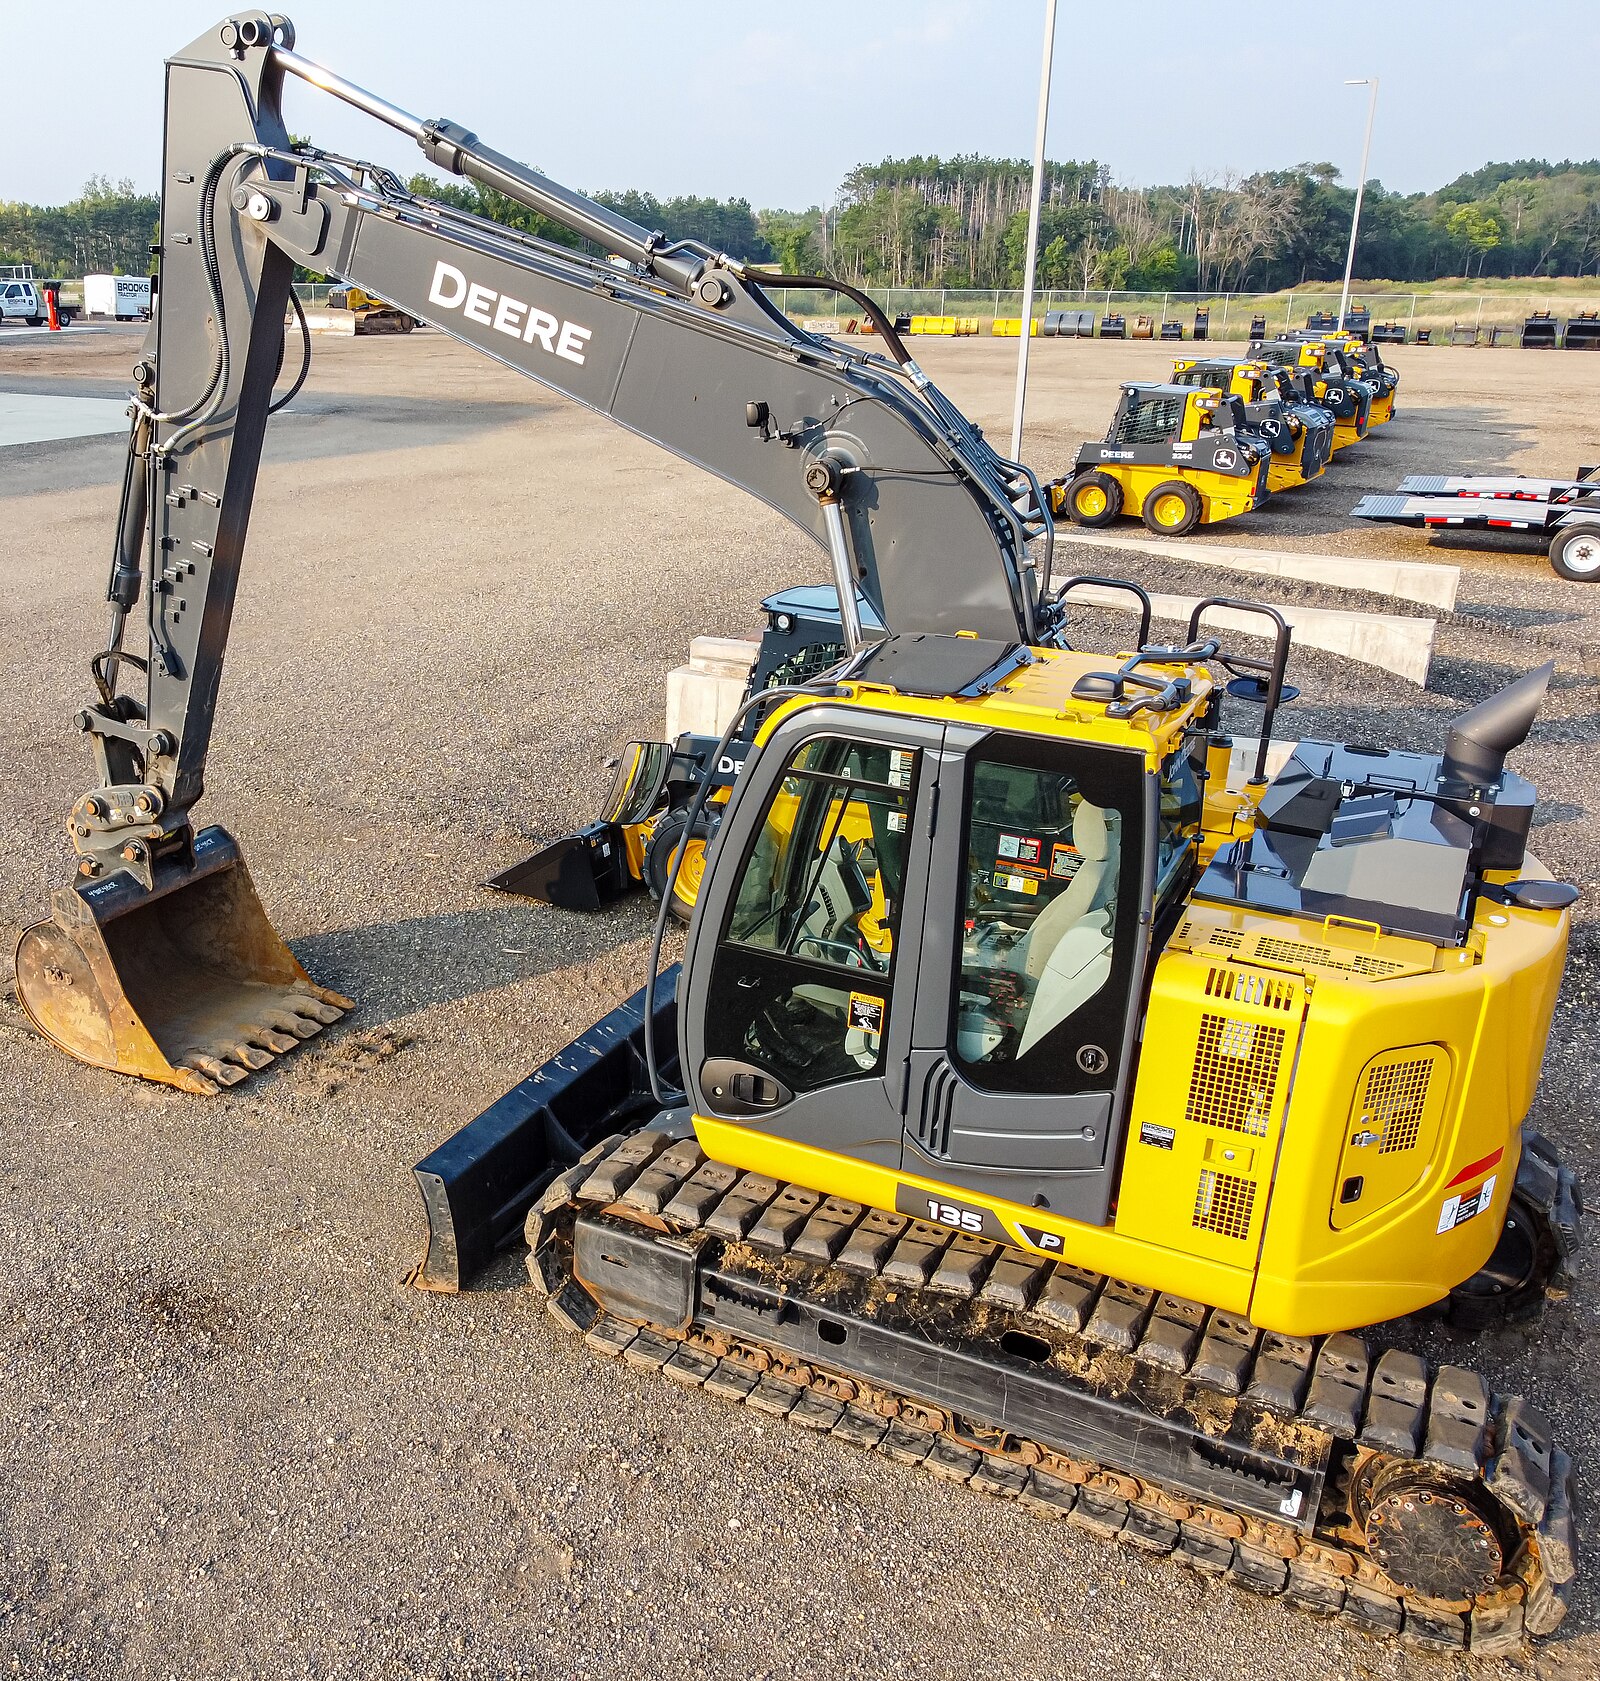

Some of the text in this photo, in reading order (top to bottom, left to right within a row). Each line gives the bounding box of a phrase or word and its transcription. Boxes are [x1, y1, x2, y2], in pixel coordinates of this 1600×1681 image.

[117, 282, 149, 292] BROOKS
[428, 260, 592, 365] DEERE
[1100, 449, 1135, 459] DEERE
[927, 1200, 1061, 1249] 135 P
